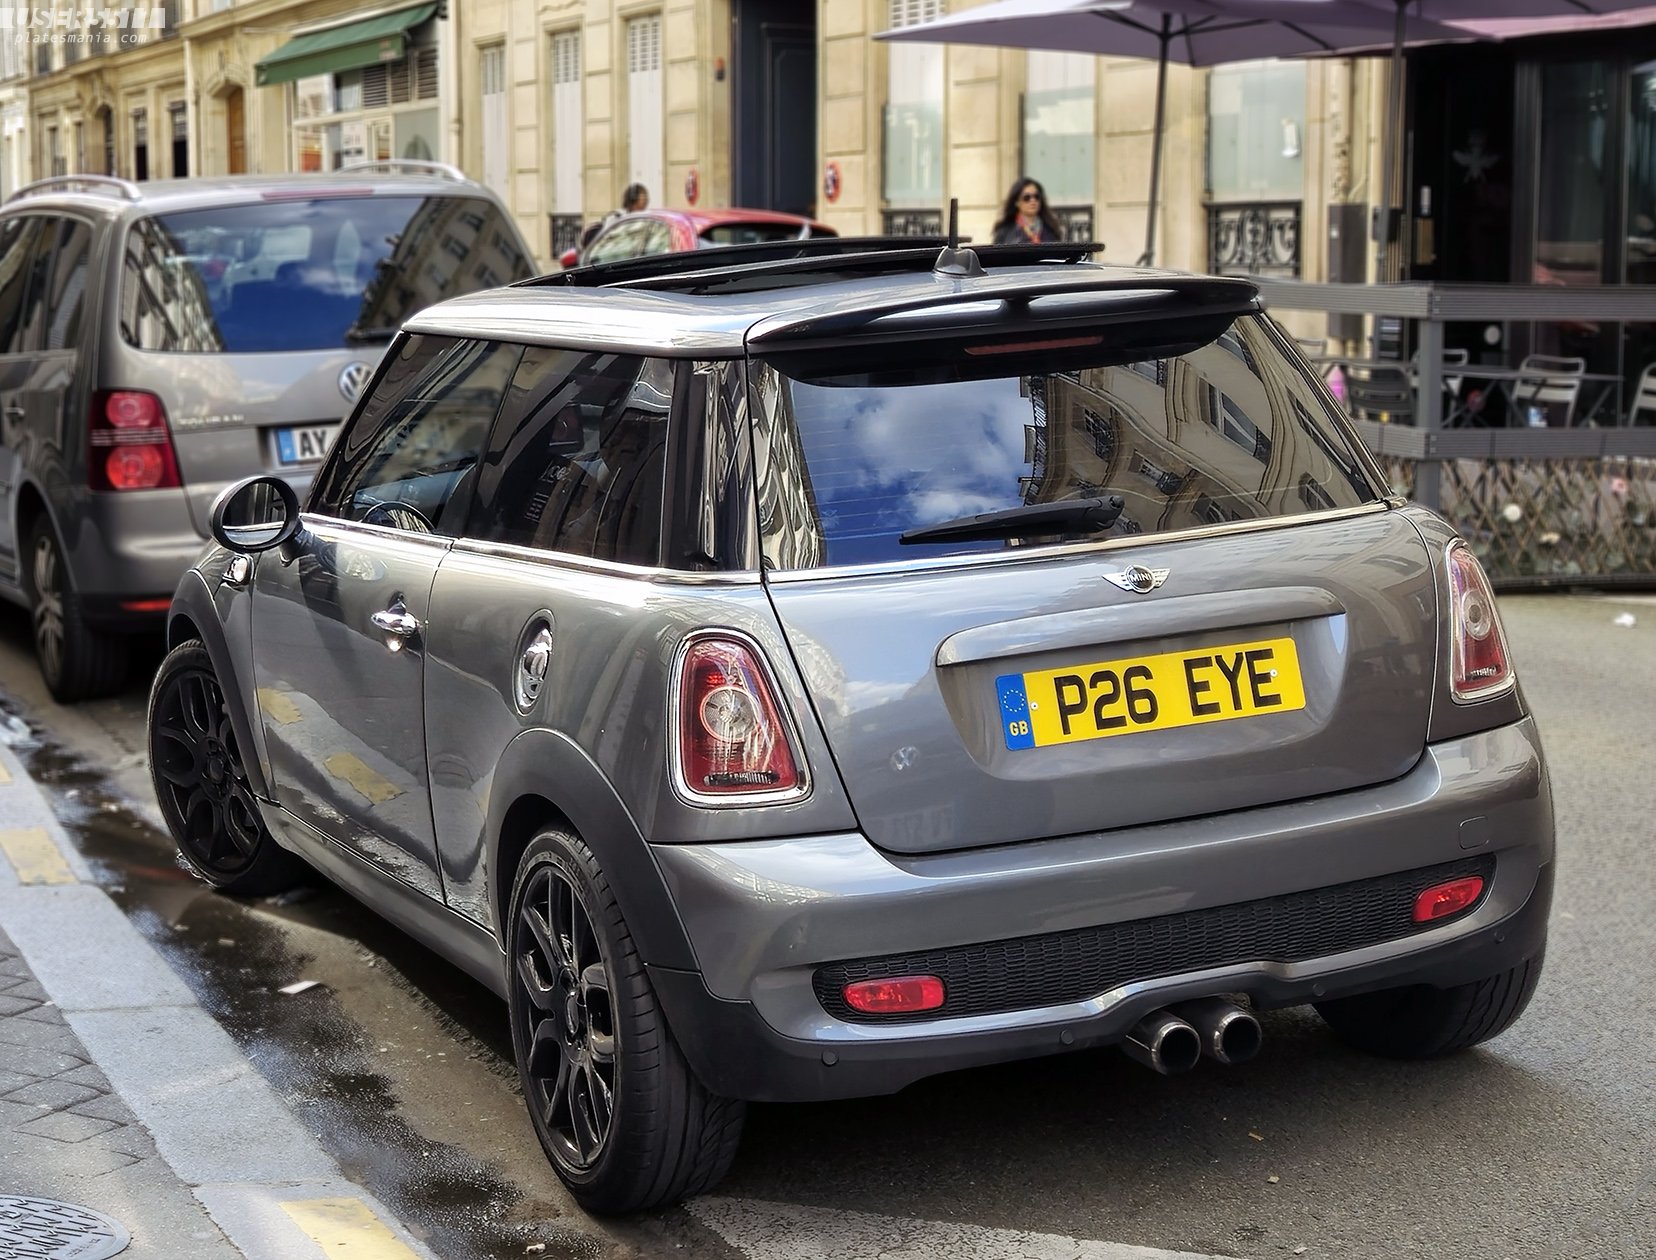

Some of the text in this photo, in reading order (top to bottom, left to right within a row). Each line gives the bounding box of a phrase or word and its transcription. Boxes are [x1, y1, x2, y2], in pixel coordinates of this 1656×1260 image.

[1130, 572, 1152, 583] MINI
[1054, 648, 1283, 736] P26 EYE
[1009, 720, 1029, 737] GB
